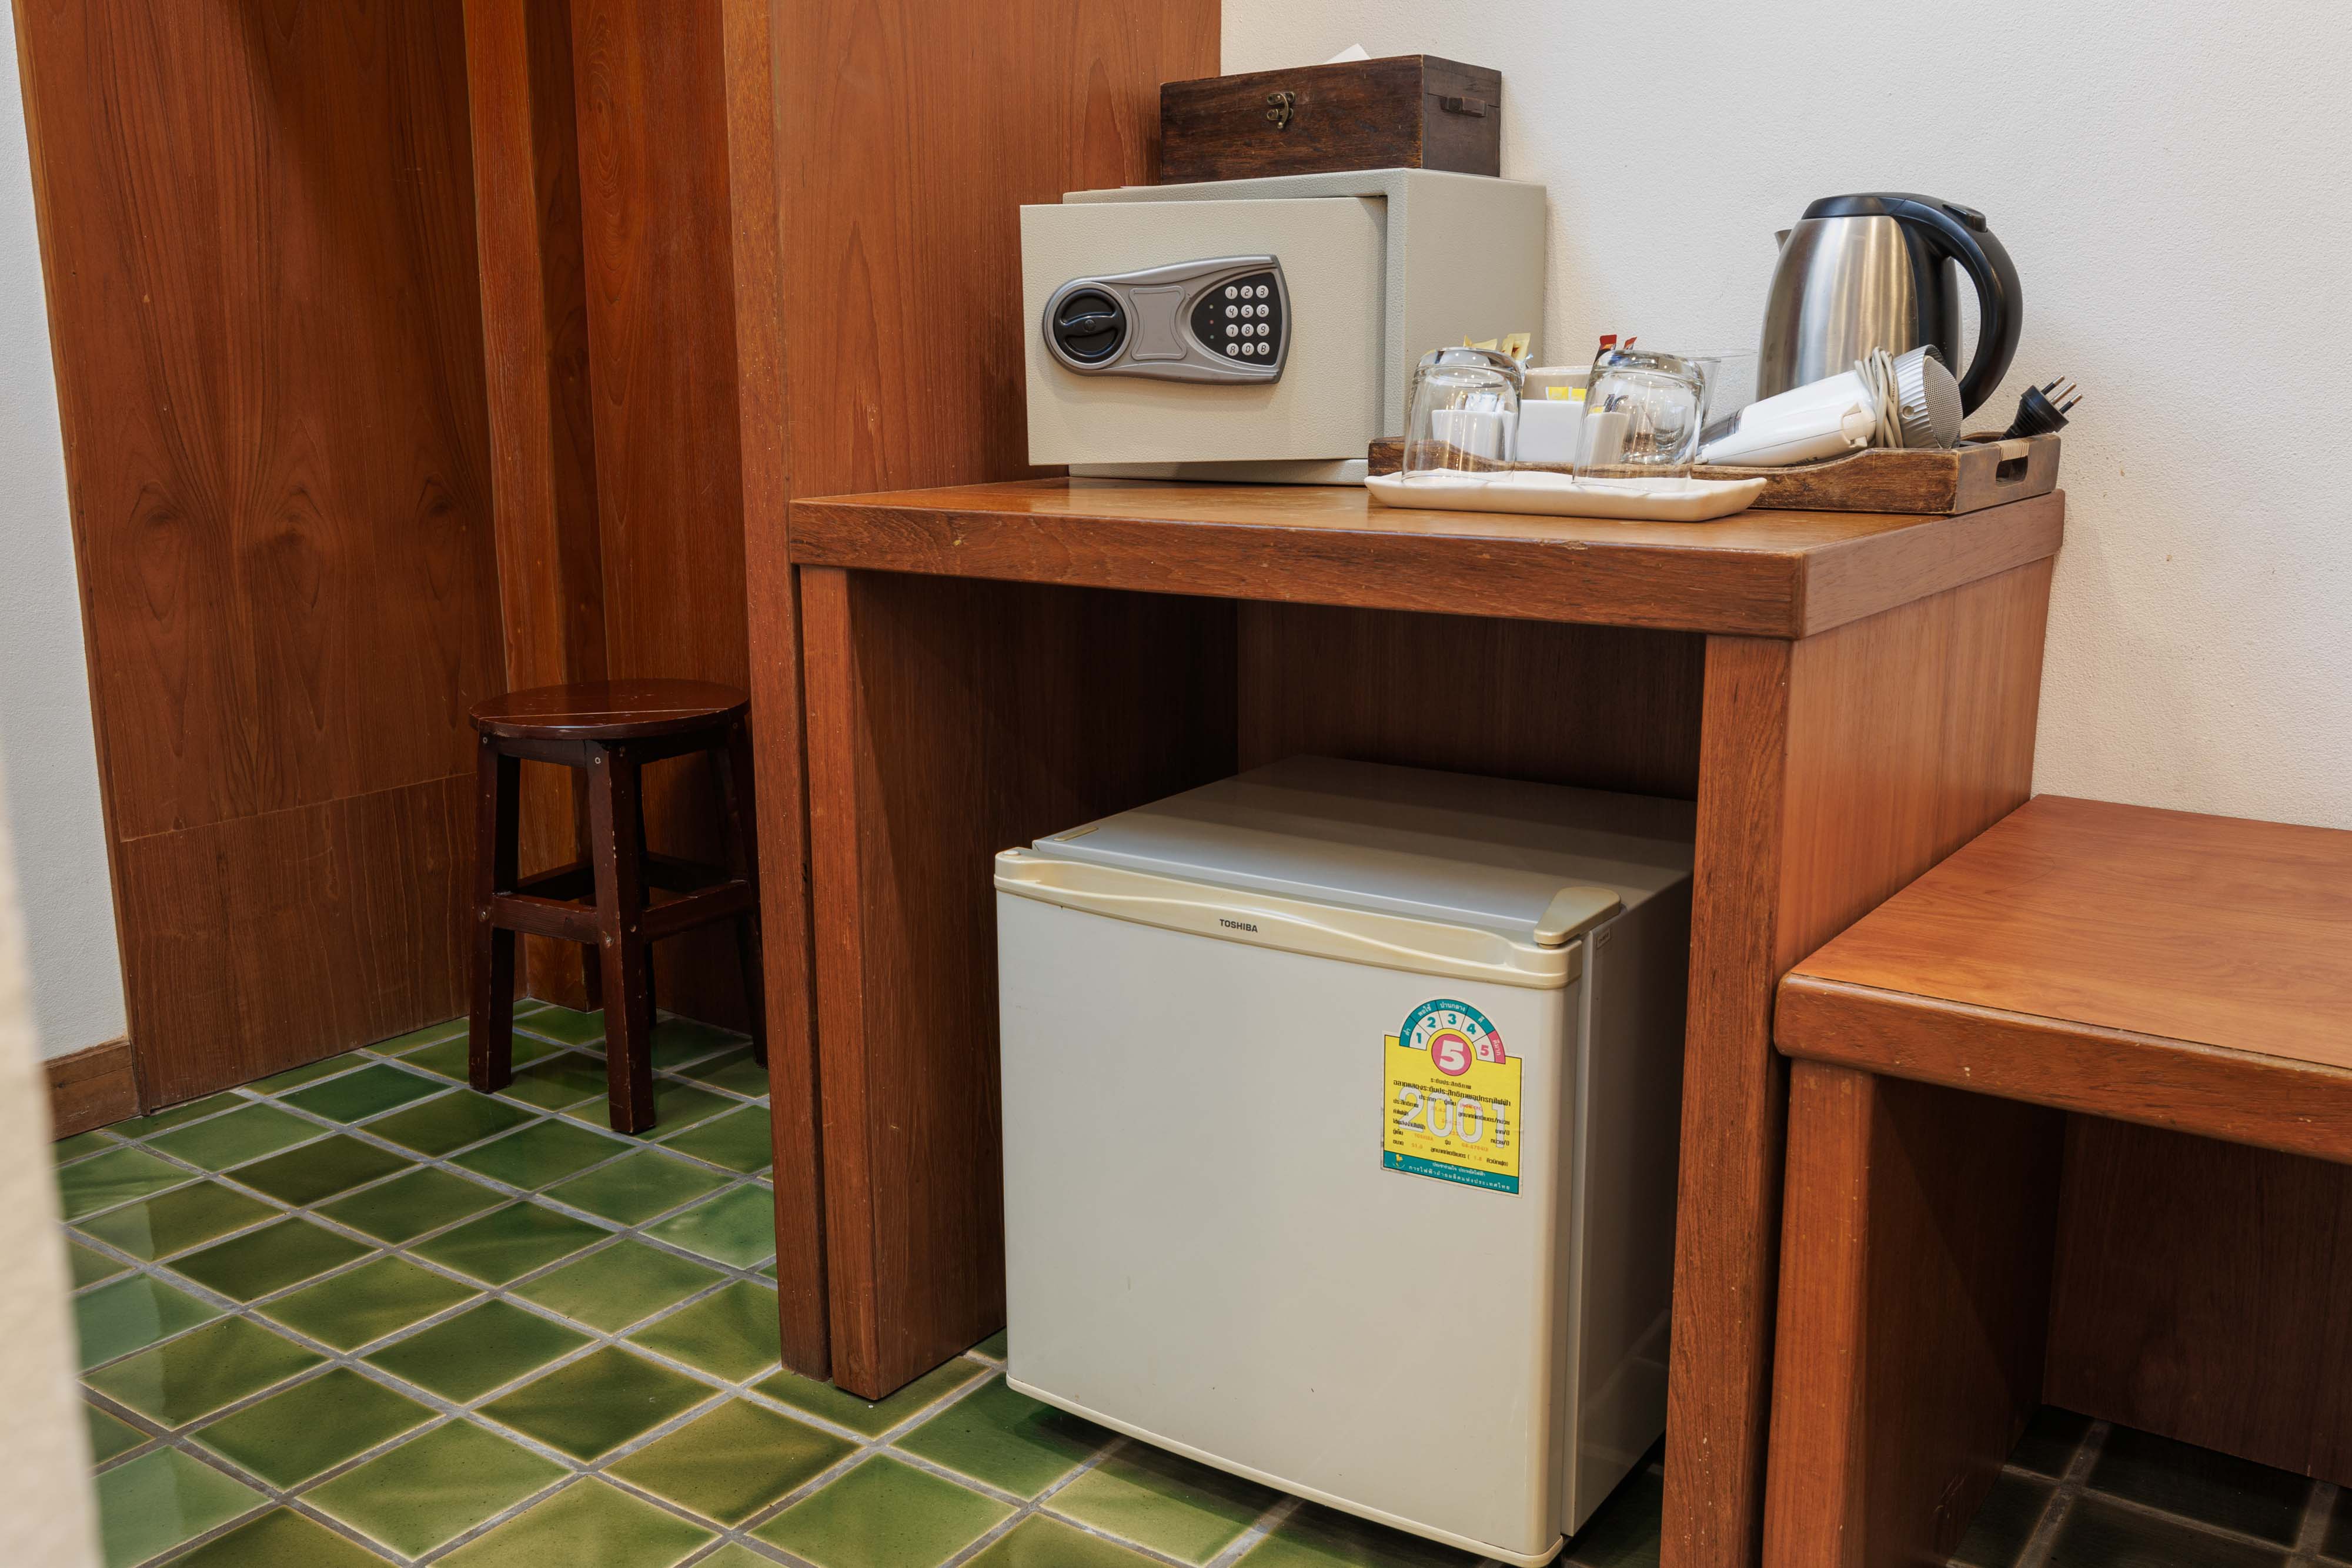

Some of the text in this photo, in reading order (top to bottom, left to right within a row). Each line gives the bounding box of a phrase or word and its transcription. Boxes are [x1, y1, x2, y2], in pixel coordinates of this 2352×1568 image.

[1219, 918, 1258, 933] TOSHIBA
[1416, 1014, 1489, 1056] 1 2 3 4 5
[1439, 1039, 1465, 1071] 5
[1398, 1086, 1505, 1148] 2001
